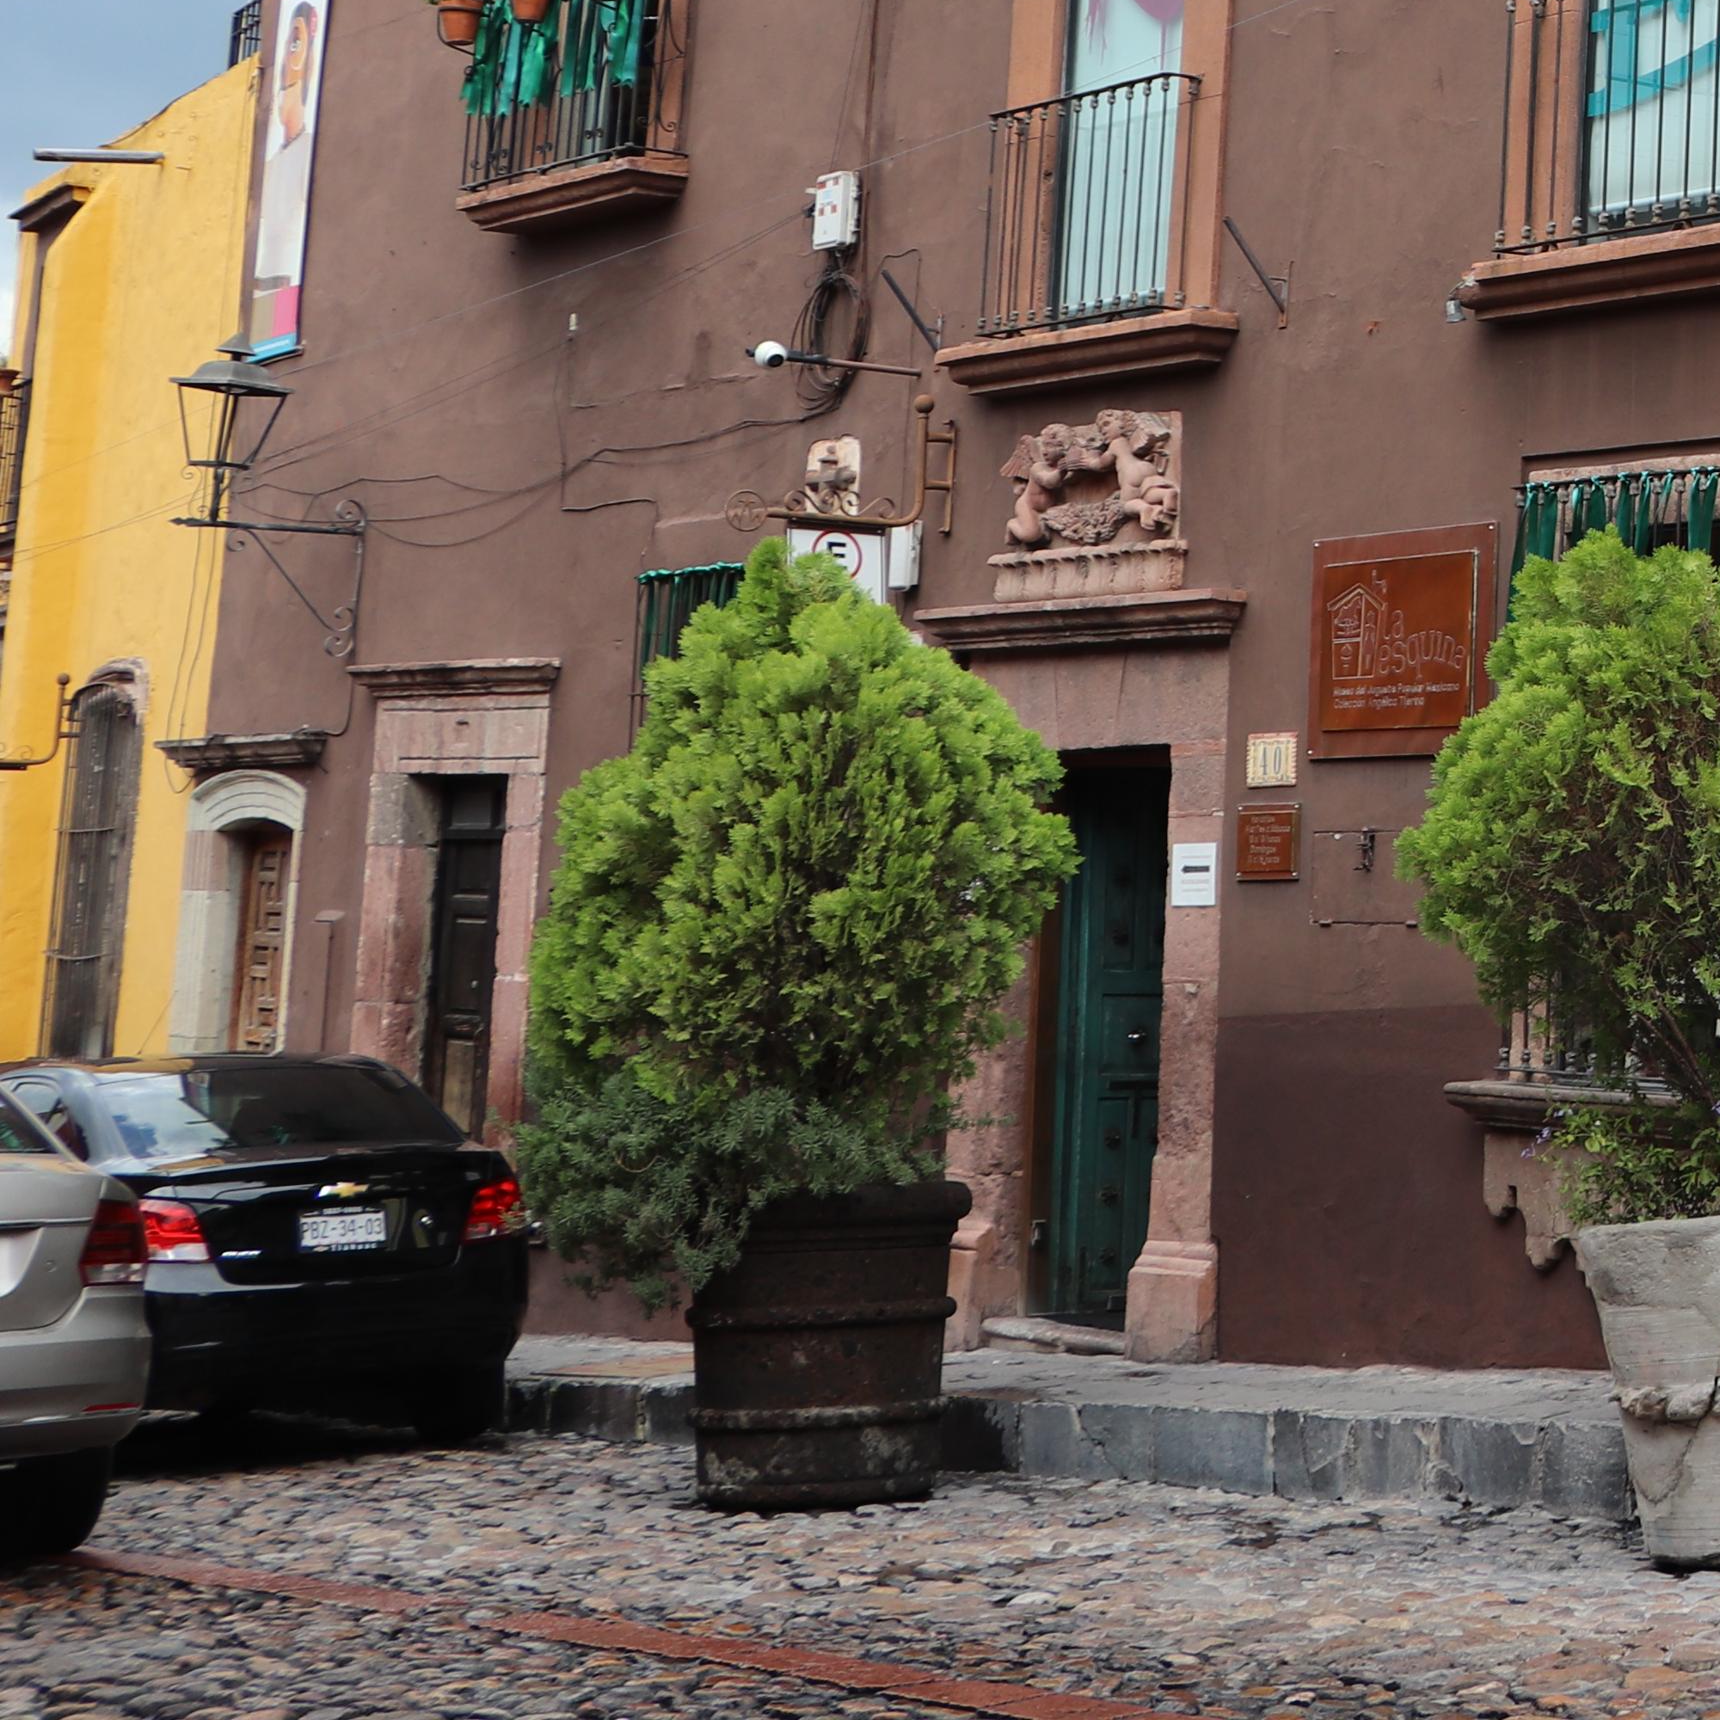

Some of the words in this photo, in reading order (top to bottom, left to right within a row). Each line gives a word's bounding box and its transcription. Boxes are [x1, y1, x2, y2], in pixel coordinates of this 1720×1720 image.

[1378, 630, 1466, 680] esquina
[1259, 746, 1282, 776] 40
[301, 1217, 383, 1240] PBZ-34-03
